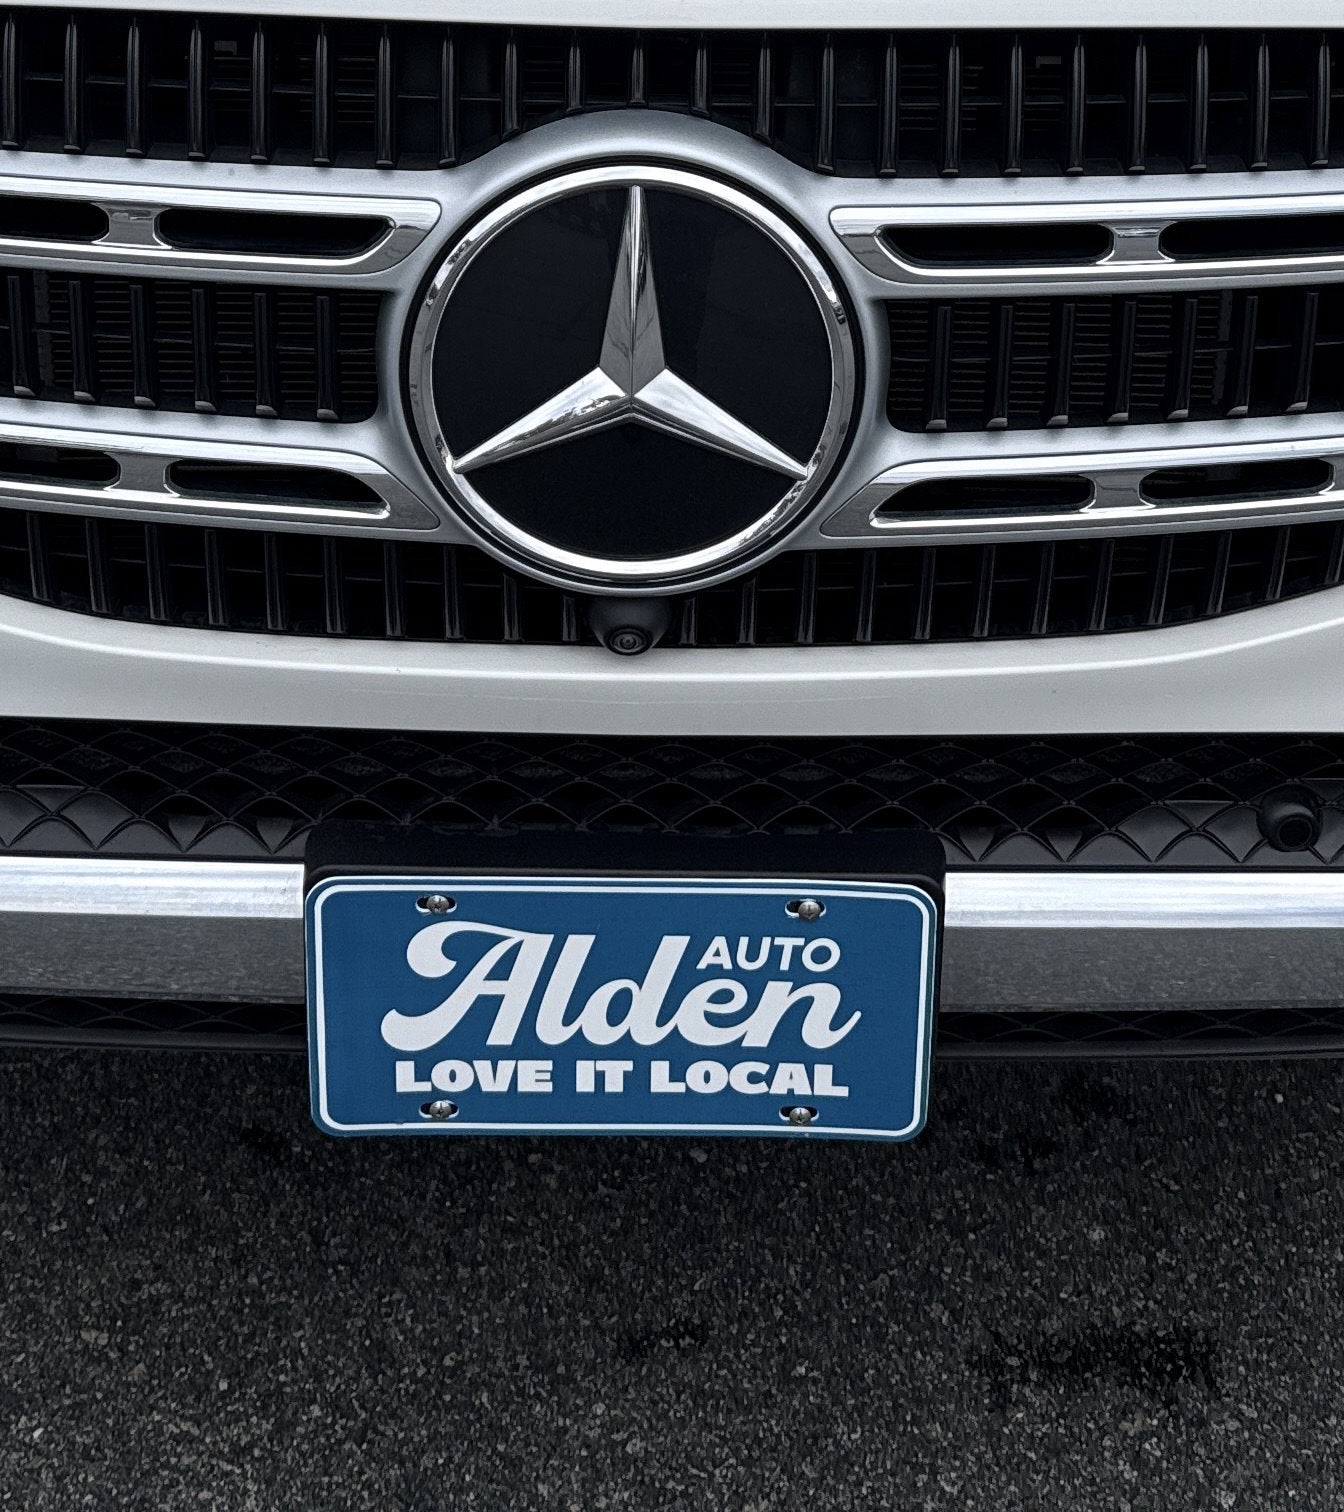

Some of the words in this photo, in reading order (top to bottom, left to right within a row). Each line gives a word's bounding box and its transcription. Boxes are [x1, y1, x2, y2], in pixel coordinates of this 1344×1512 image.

[696, 935, 841, 973] AUTO
[380, 920, 862, 1052] Alden
[395, 1059, 553, 1094] LOVE
[575, 1060, 634, 1094] IT
[650, 1060, 849, 1097] LOCAL
